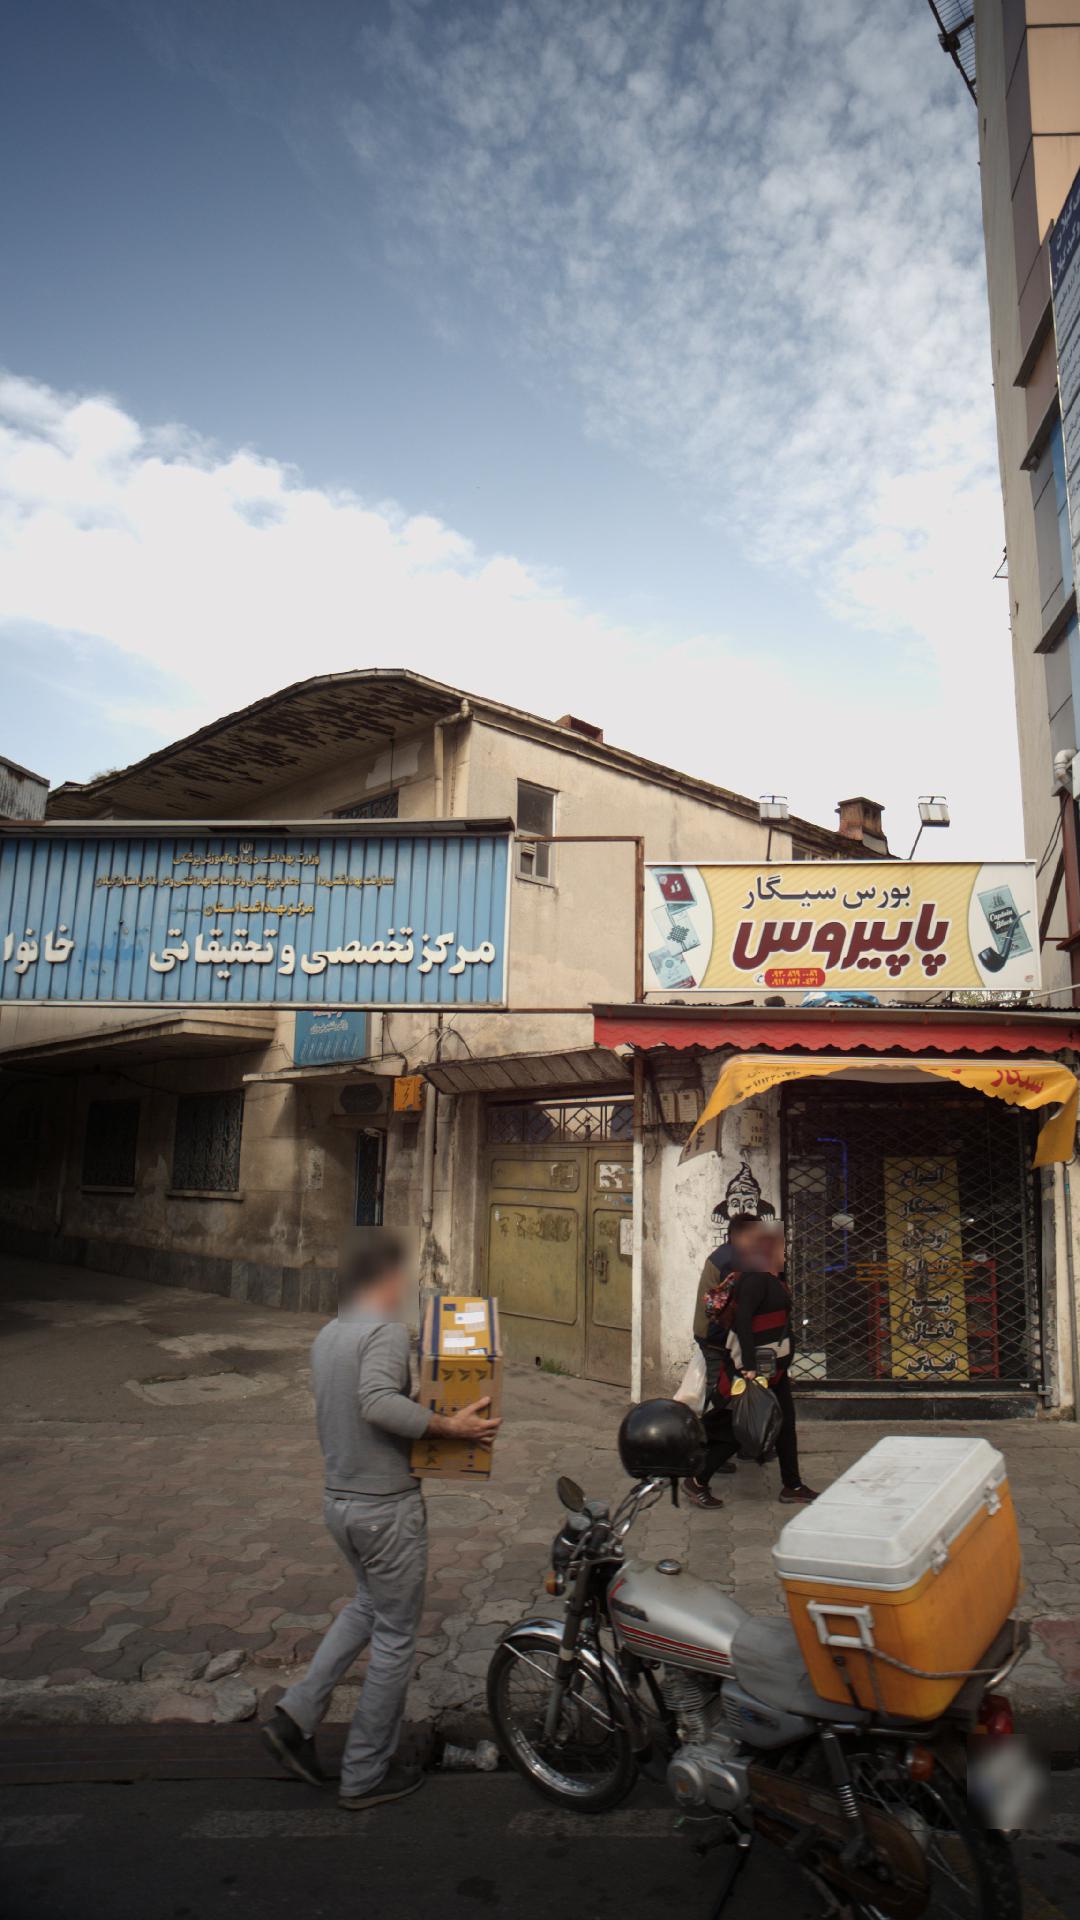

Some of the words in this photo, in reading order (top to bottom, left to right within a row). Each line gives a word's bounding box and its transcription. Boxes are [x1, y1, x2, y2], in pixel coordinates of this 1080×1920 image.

[261, 852, 295, 867] بهداشت
[295, 852, 320, 867] وزارت
[741, 875, 837, 909] سیگار
[842, 884, 911, 908] بورس
[204, 901, 240, 917] استان
[240, 900, 287, 917] بهداشت
[287, 900, 315, 917] مرکز
[300, 926, 414, 975] تخصصی
[731, 903, 950, 977] پاپیروس
[150, 928, 275, 979] تحقیقاتی
[278, 944, 296, 975] و
[417, 931, 496, 975] مرکز
[907, 1352, 957, 1374] فندک
